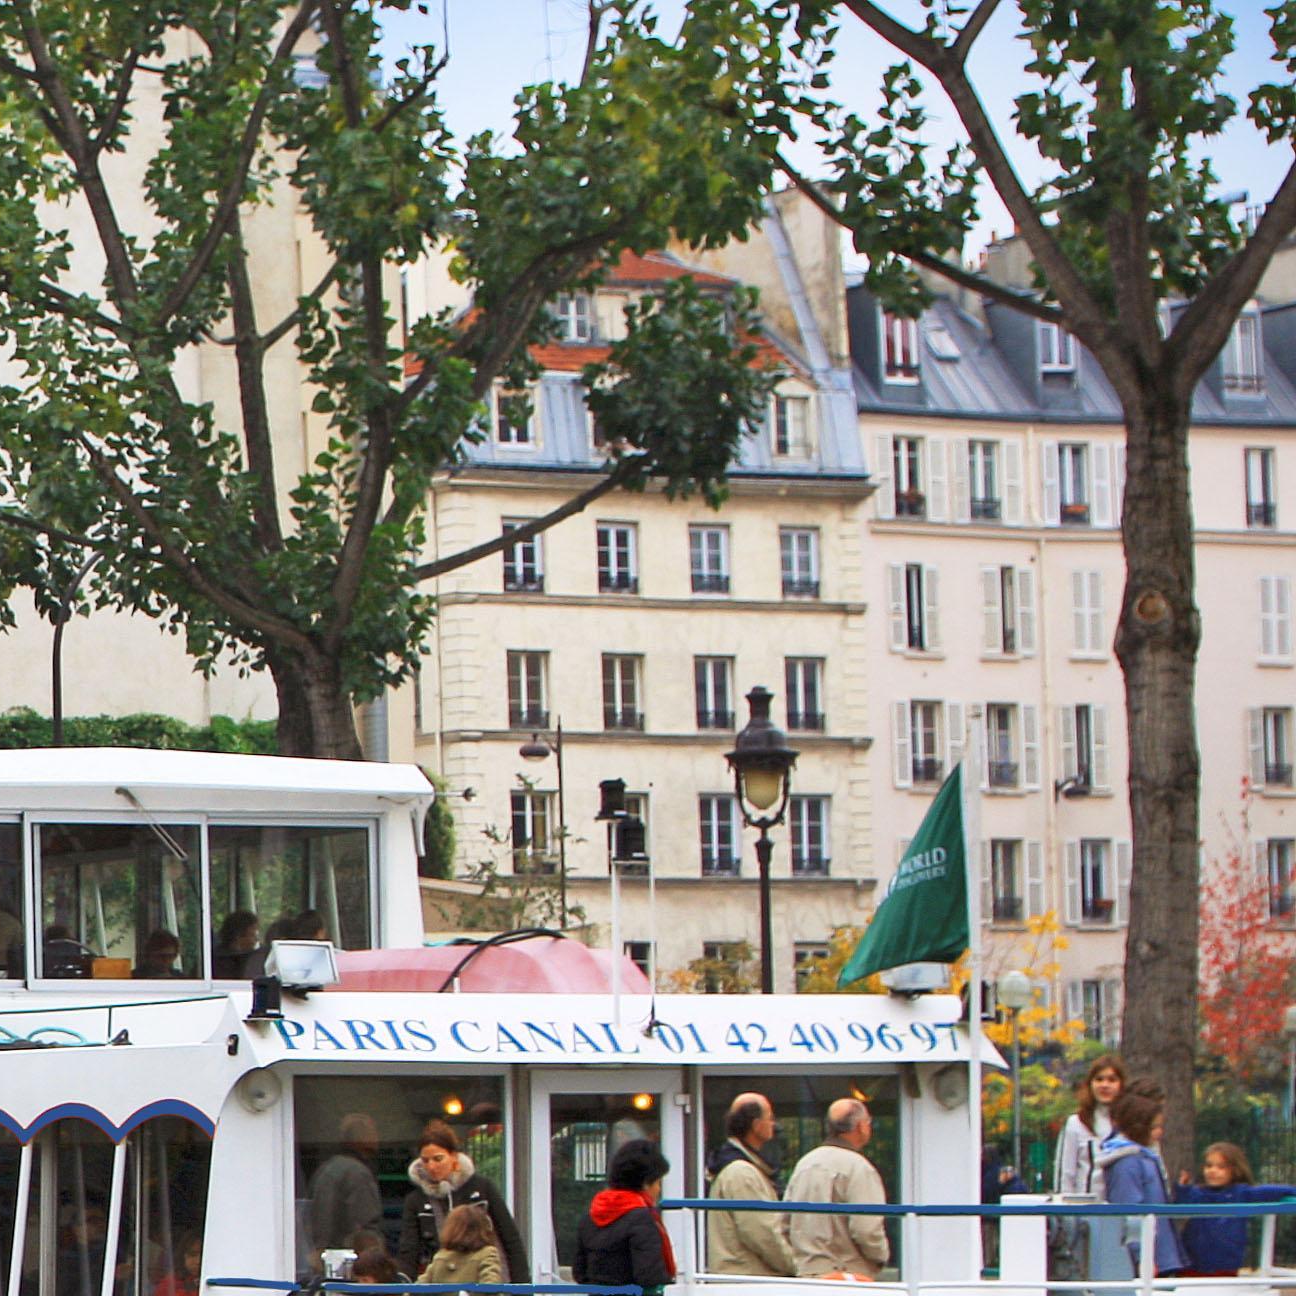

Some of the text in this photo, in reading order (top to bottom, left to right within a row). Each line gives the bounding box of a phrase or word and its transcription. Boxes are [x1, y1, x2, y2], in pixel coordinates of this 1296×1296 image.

[274, 1018, 438, 1052] PARIS
[449, 1020, 641, 1054] CANAL
[725, 1022, 778, 1053] 42
[789, 1022, 840, 1054] 40
